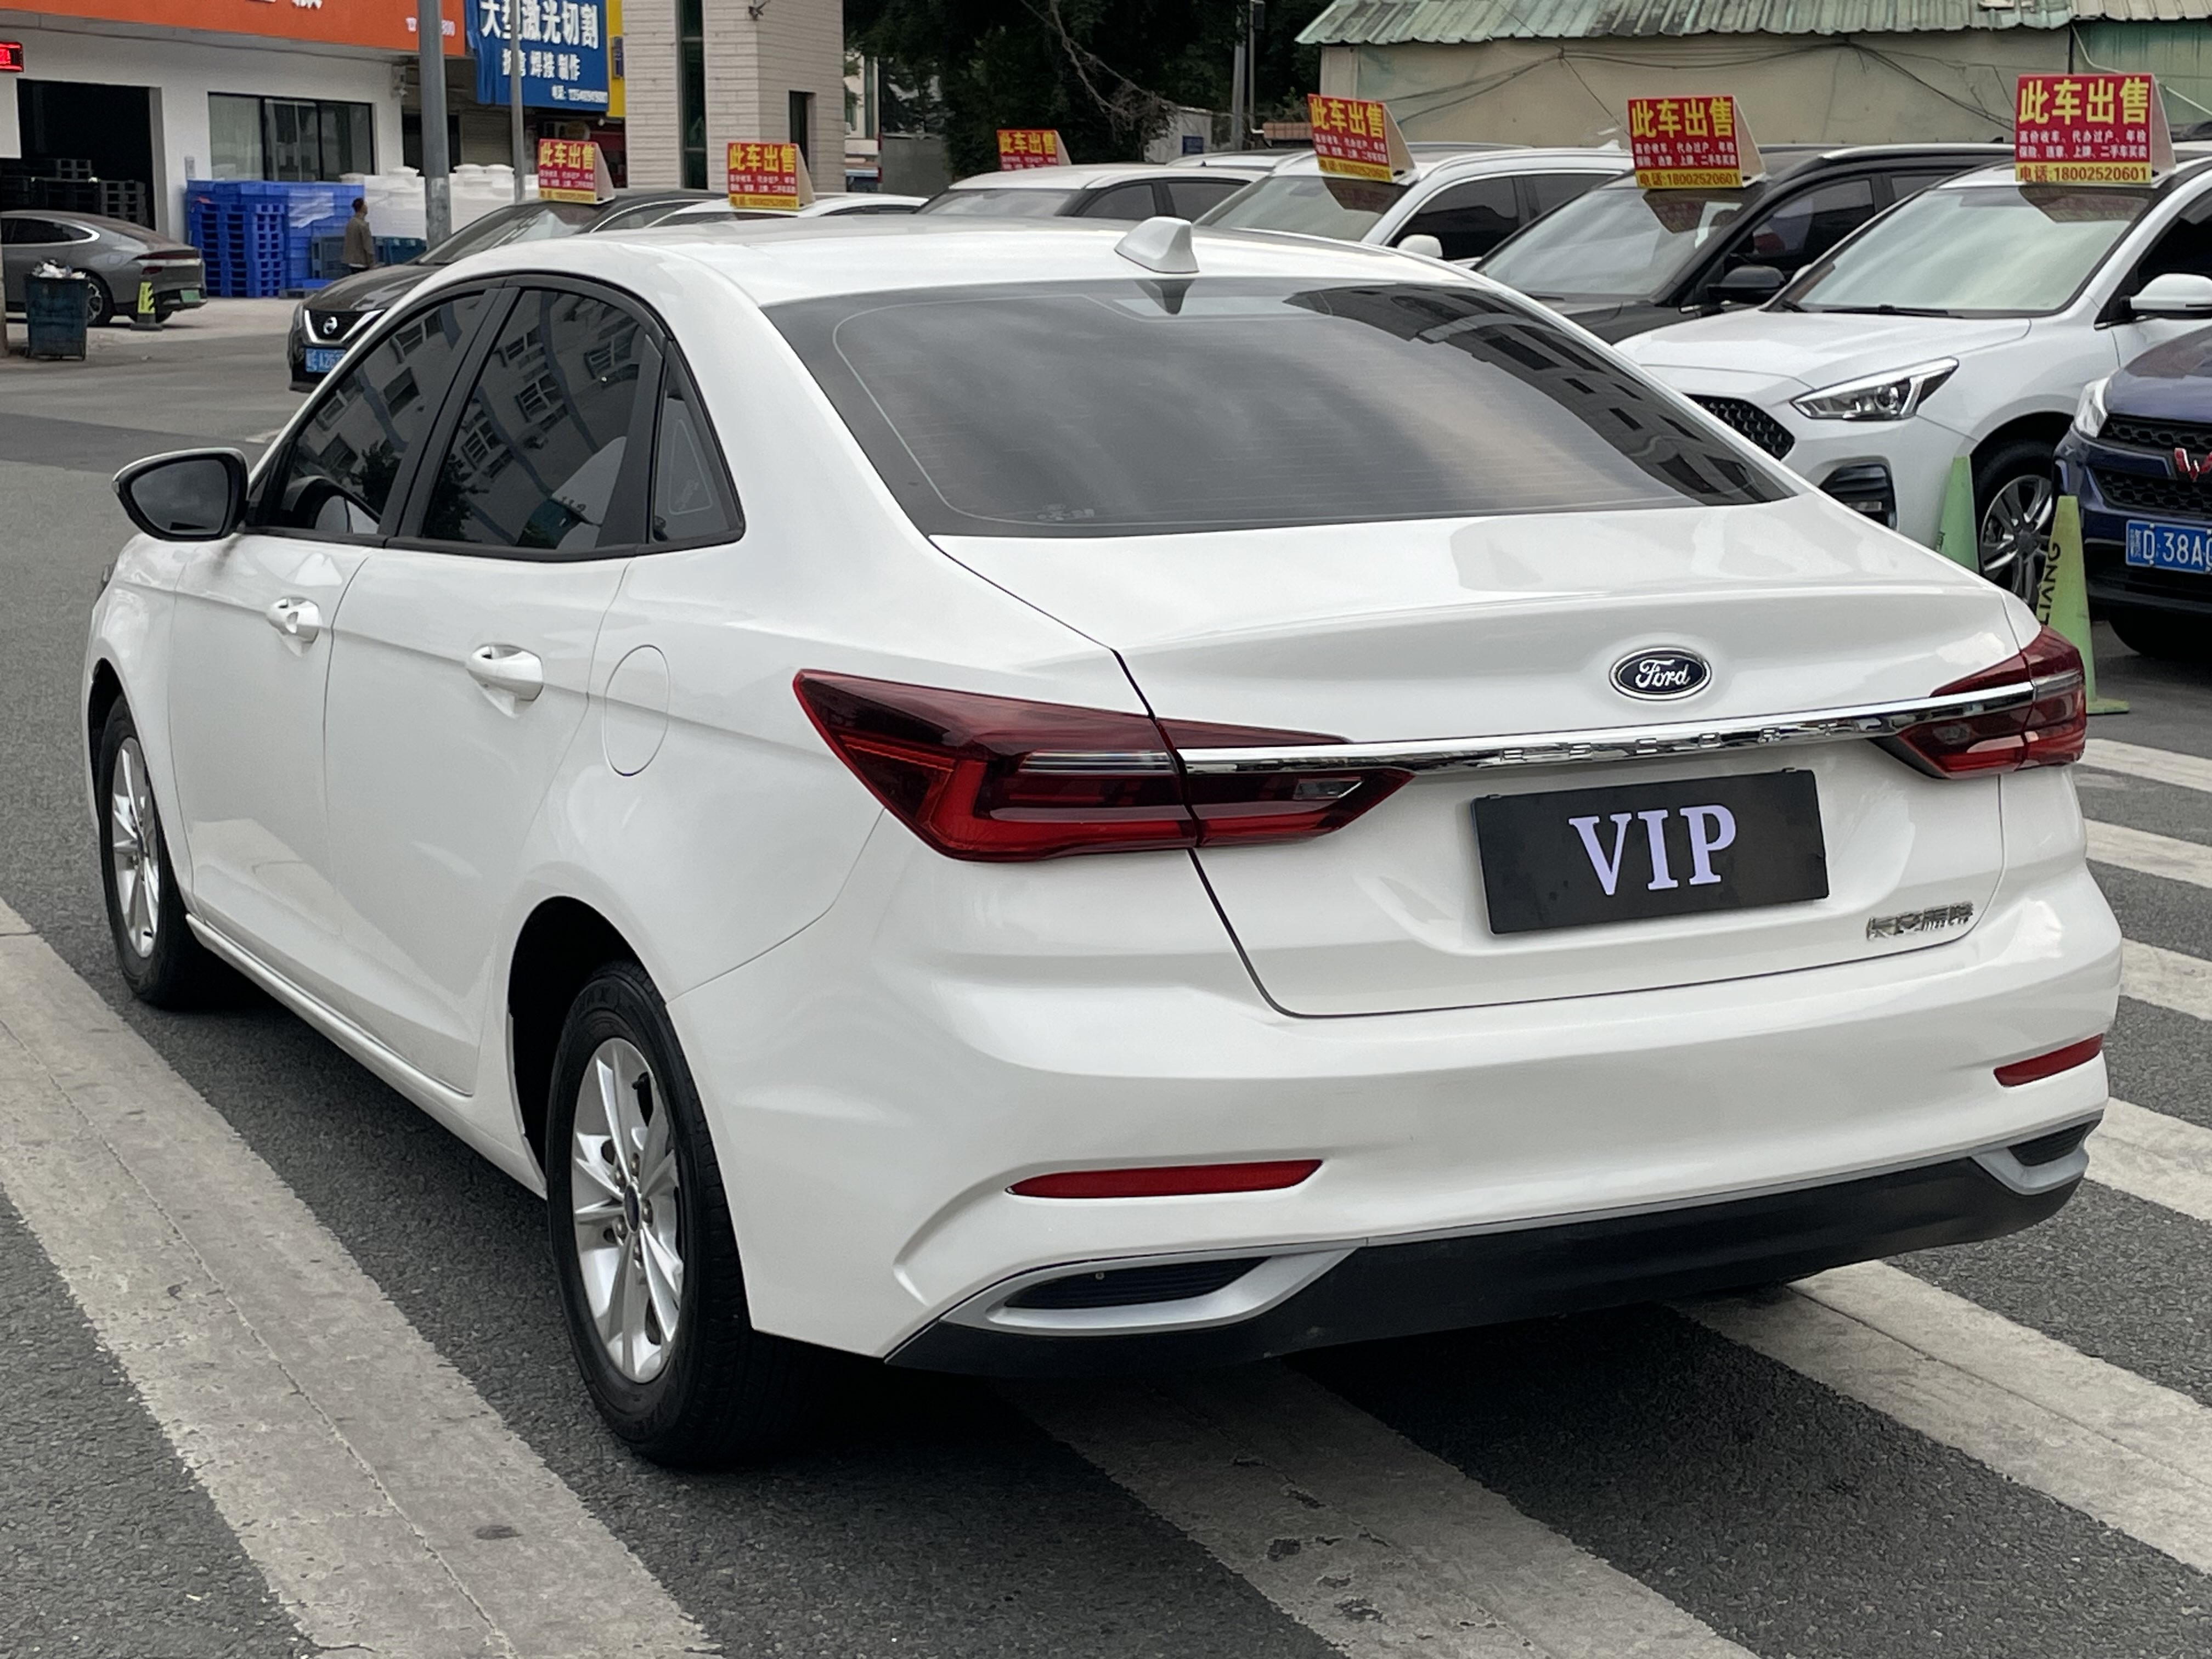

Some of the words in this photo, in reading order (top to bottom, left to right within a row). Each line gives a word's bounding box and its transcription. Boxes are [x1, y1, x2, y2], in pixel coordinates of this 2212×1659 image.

[1310, 96, 1384, 139] 此车出售
[1632, 97, 1733, 138] 此车出售
[2019, 77, 2149, 125] 此车出售
[539, 142, 595, 171] 此车出售
[729, 144, 795, 173] 此车出售
[998, 131, 1056, 155] 此车出售
[1635, 659, 1691, 688] Ford
[1568, 804, 1737, 896] VIP
